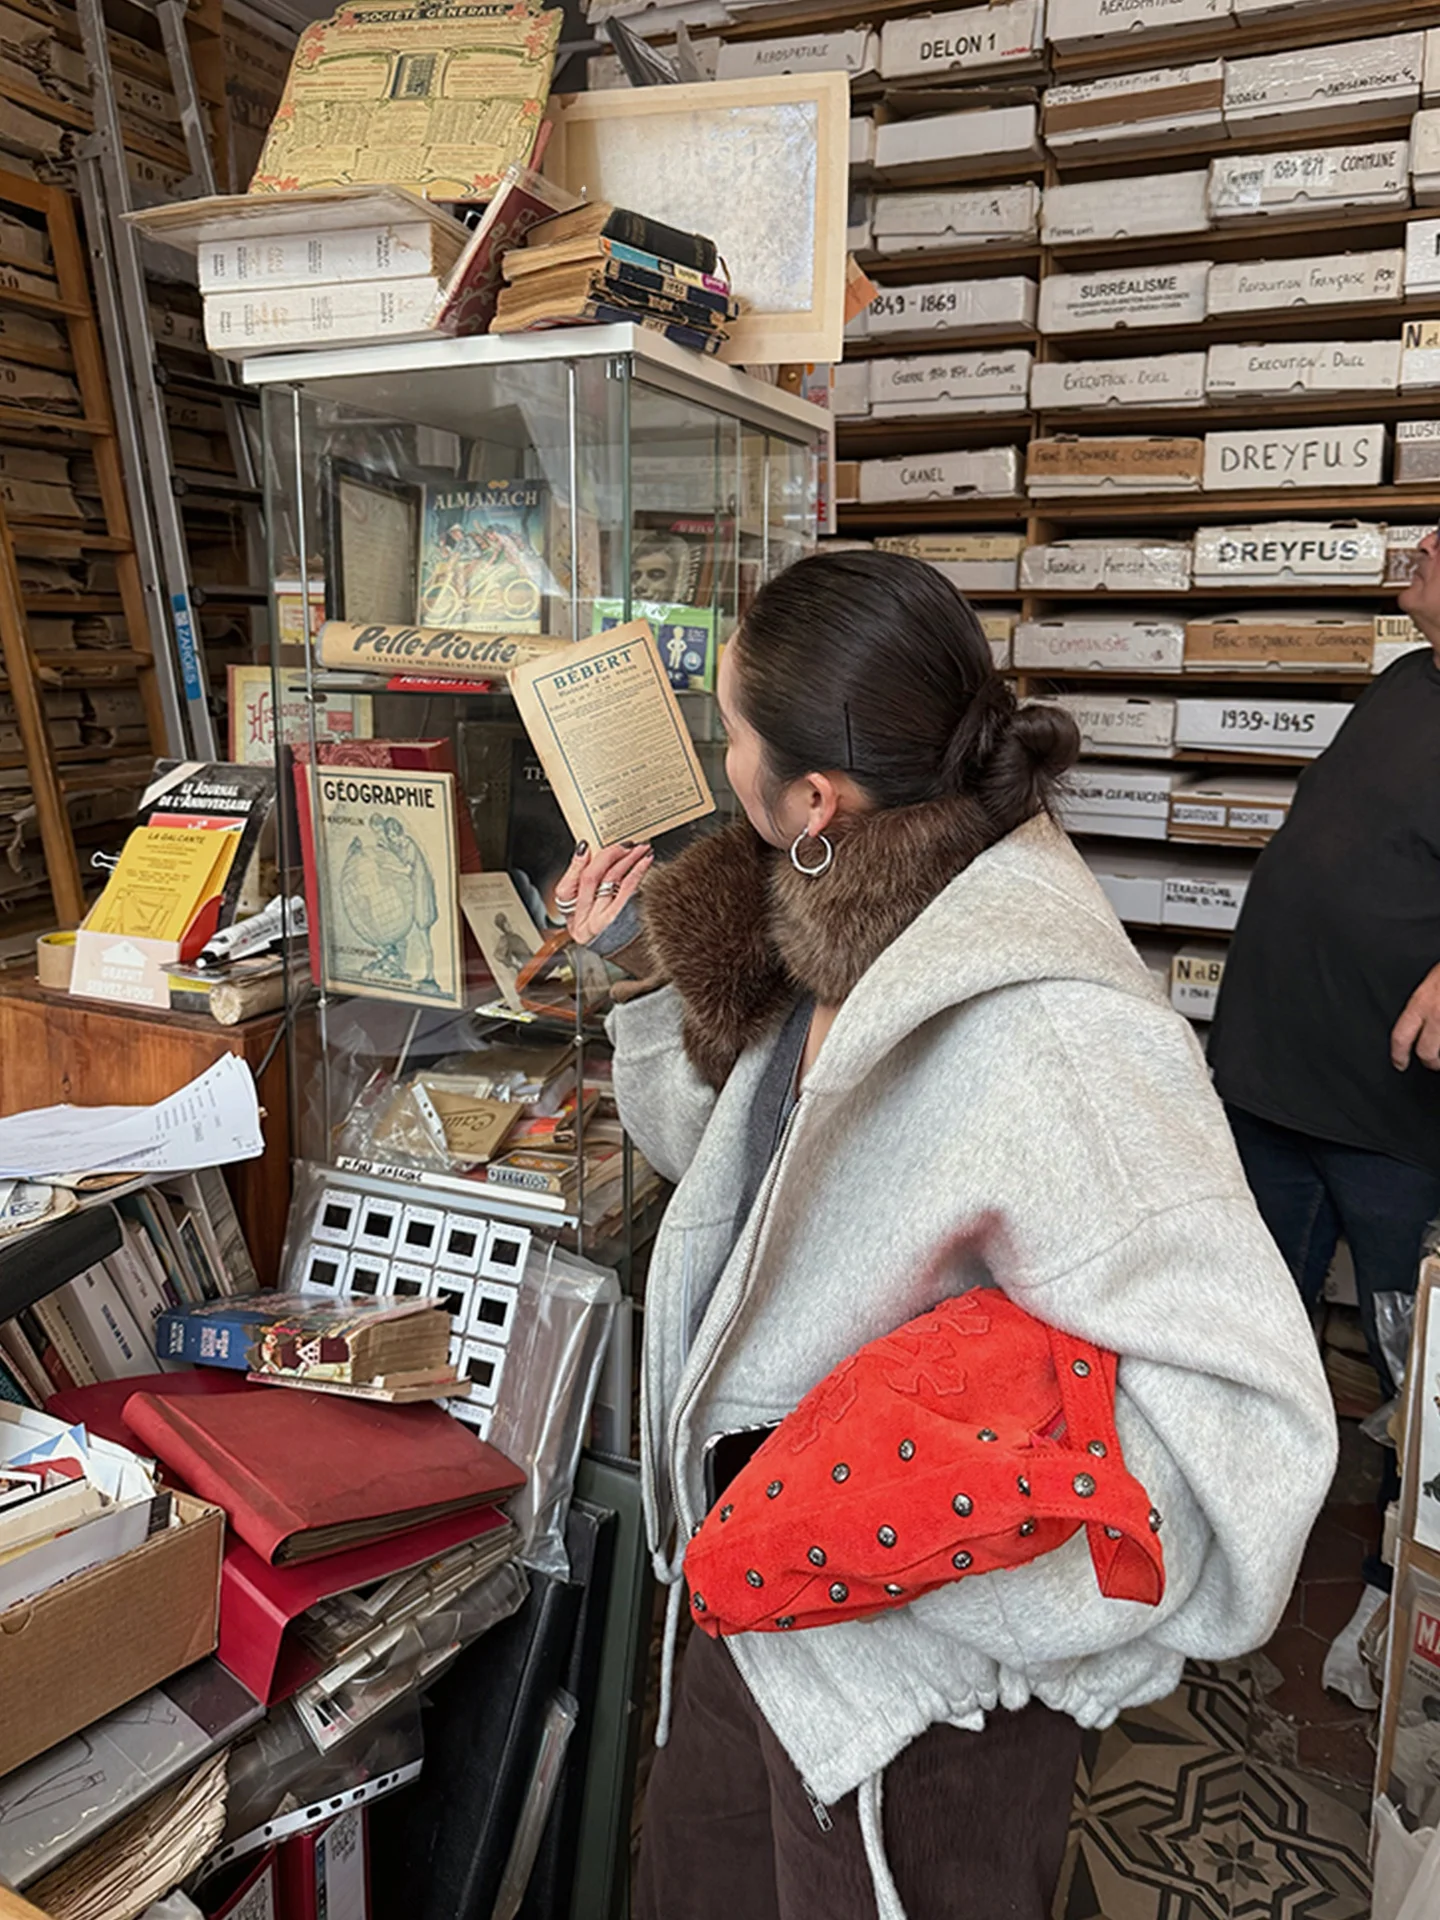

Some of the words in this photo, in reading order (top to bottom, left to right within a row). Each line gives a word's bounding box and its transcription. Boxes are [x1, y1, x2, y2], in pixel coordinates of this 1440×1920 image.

[920, 38, 981, 61] DELON
[989, 34, 996, 49] 1
[1341, 150, 1397, 173] COMMUNE
[1080, 276, 1178, 299] SURRÉALISME
[869, 295, 905, 316] 1849
[920, 294, 957, 312] 1869
[1405, 325, 1423, 349] N
[1221, 438, 1369, 472] DREYFUS
[900, 467, 945, 486] CHANEL
[433, 490, 538, 510] ALMANACH
[1218, 540, 1359, 563] DREYFUS
[353, 626, 519, 663] Pelle-Pioche
[179, 628, 196, 685] ZARGES
[1220, 709, 1315, 732] 1939-1945
[194, 781, 239, 797] JOURNAL
[324, 780, 435, 808] GÉOGRAPHIE
